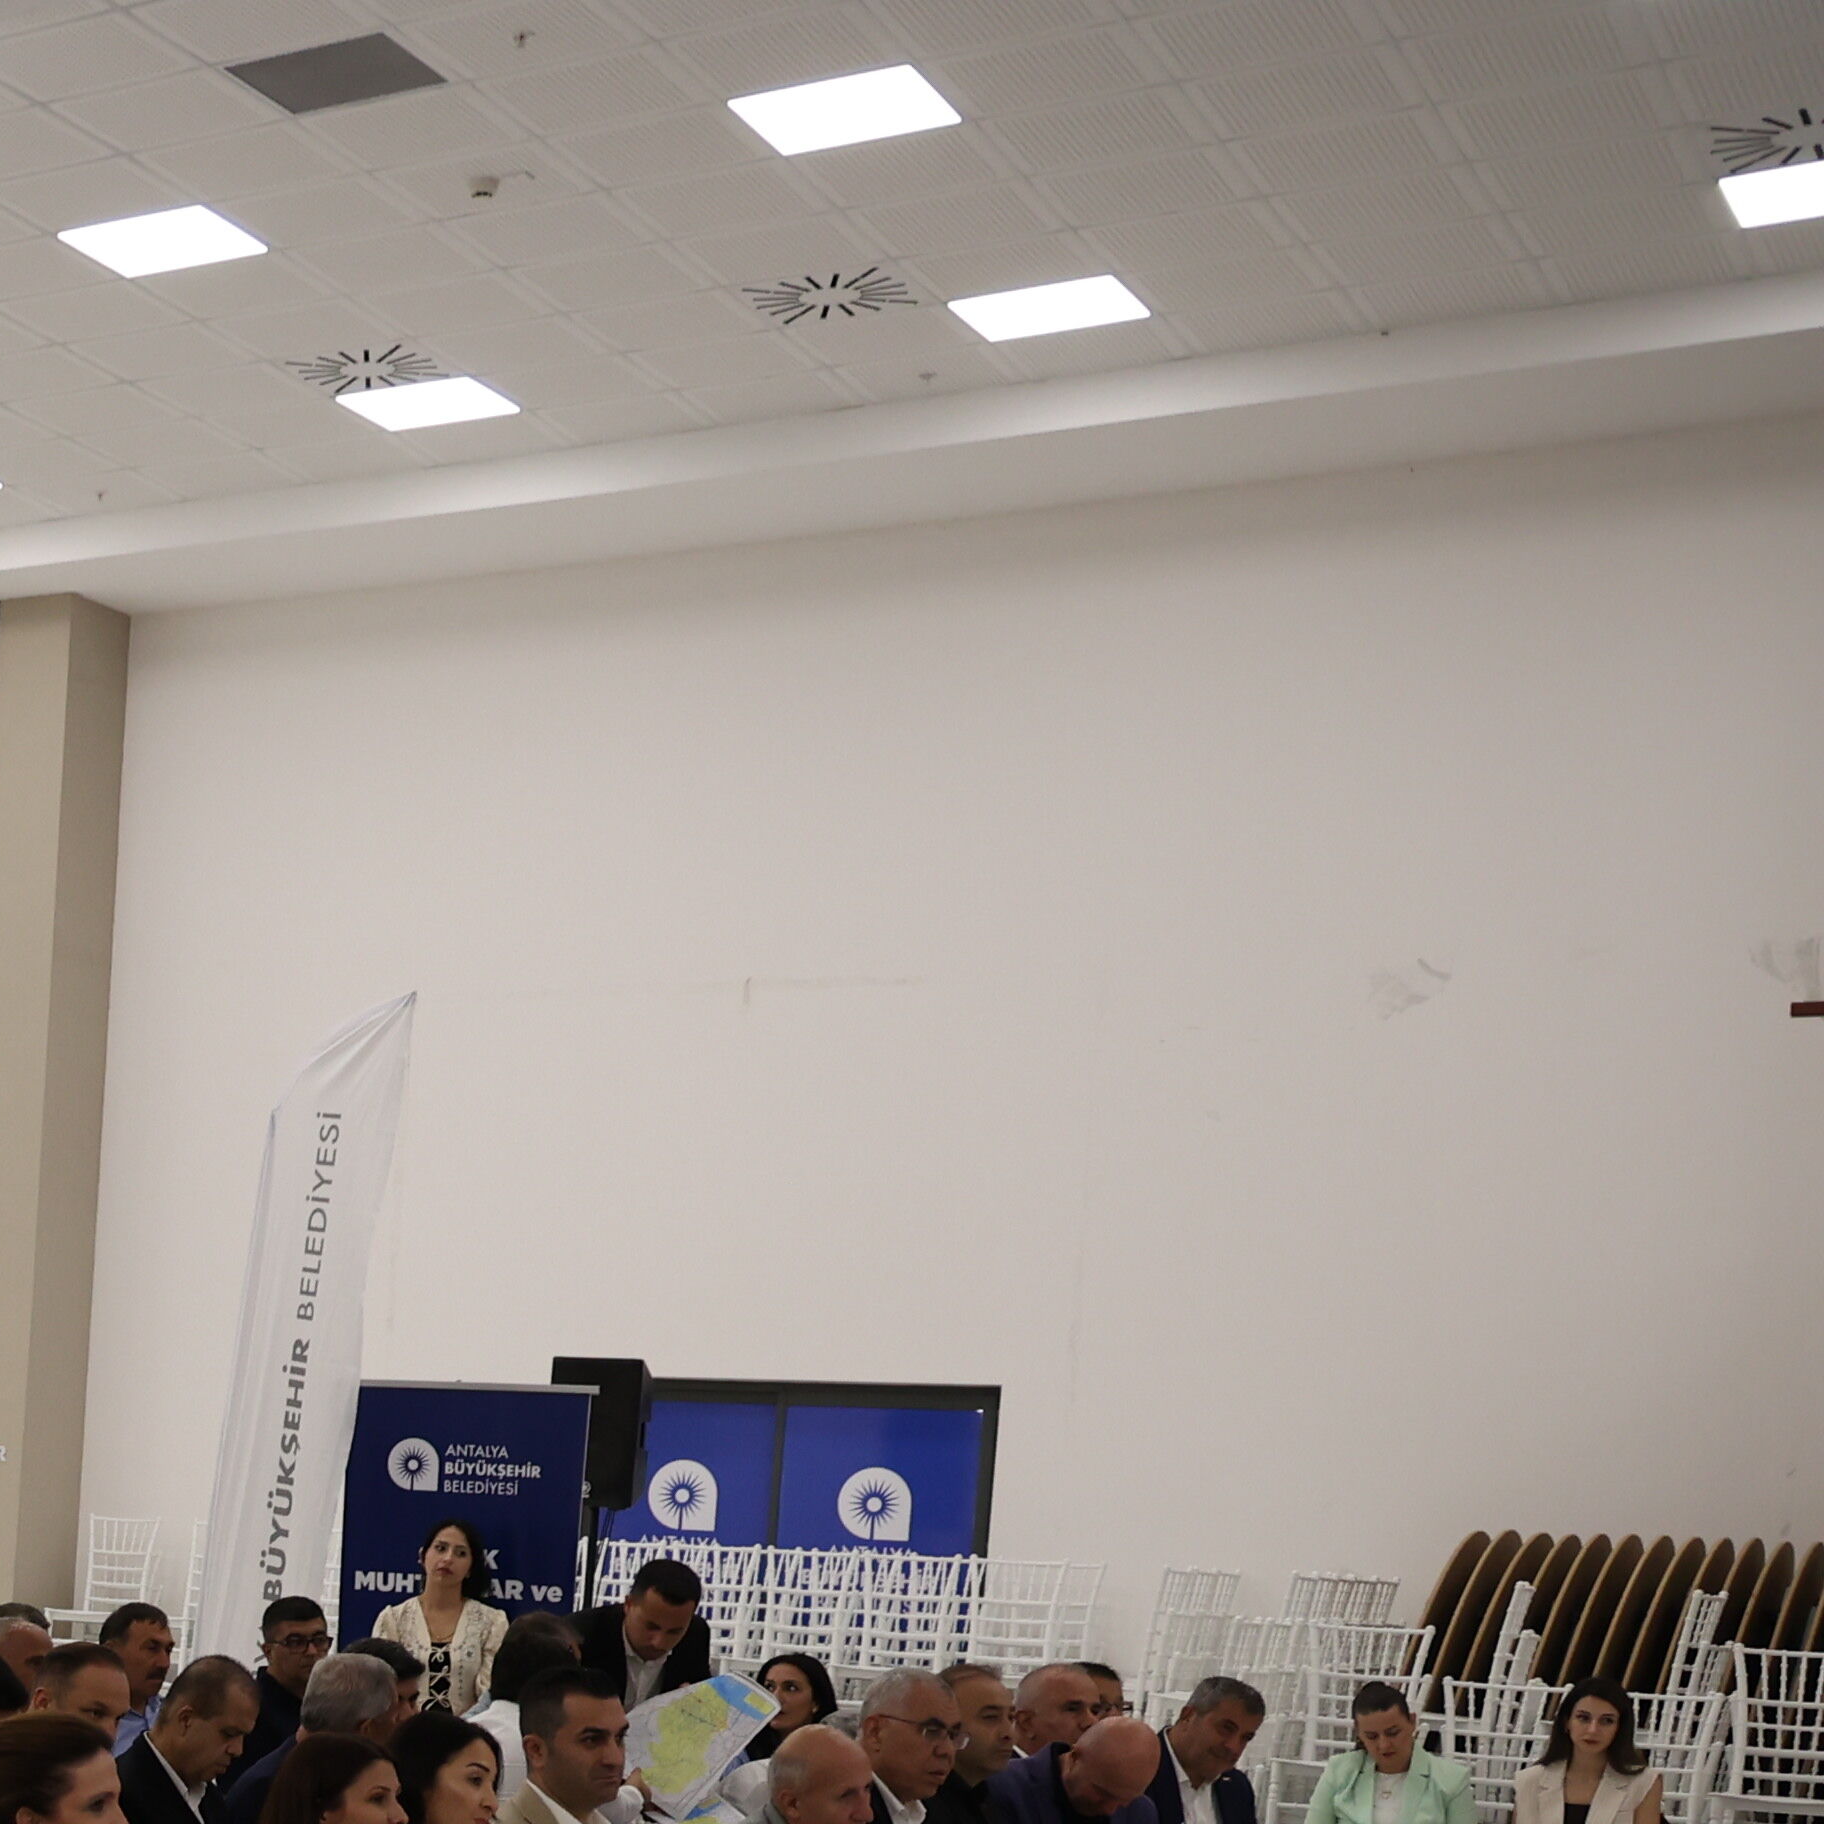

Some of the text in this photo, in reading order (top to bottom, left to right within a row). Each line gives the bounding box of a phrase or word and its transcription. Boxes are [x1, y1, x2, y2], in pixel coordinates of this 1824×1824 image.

[260, 1112, 341, 1600] BÜYÜKŞEHİR BELEDİYESİ
[445, 1444, 509, 1459] ANTALYA
[444, 1460, 541, 1480] BÜYÜKŞEHİR
[443, 1478, 519, 1496] BELEDİYESİ
[530, 1584, 563, 1603] ve
